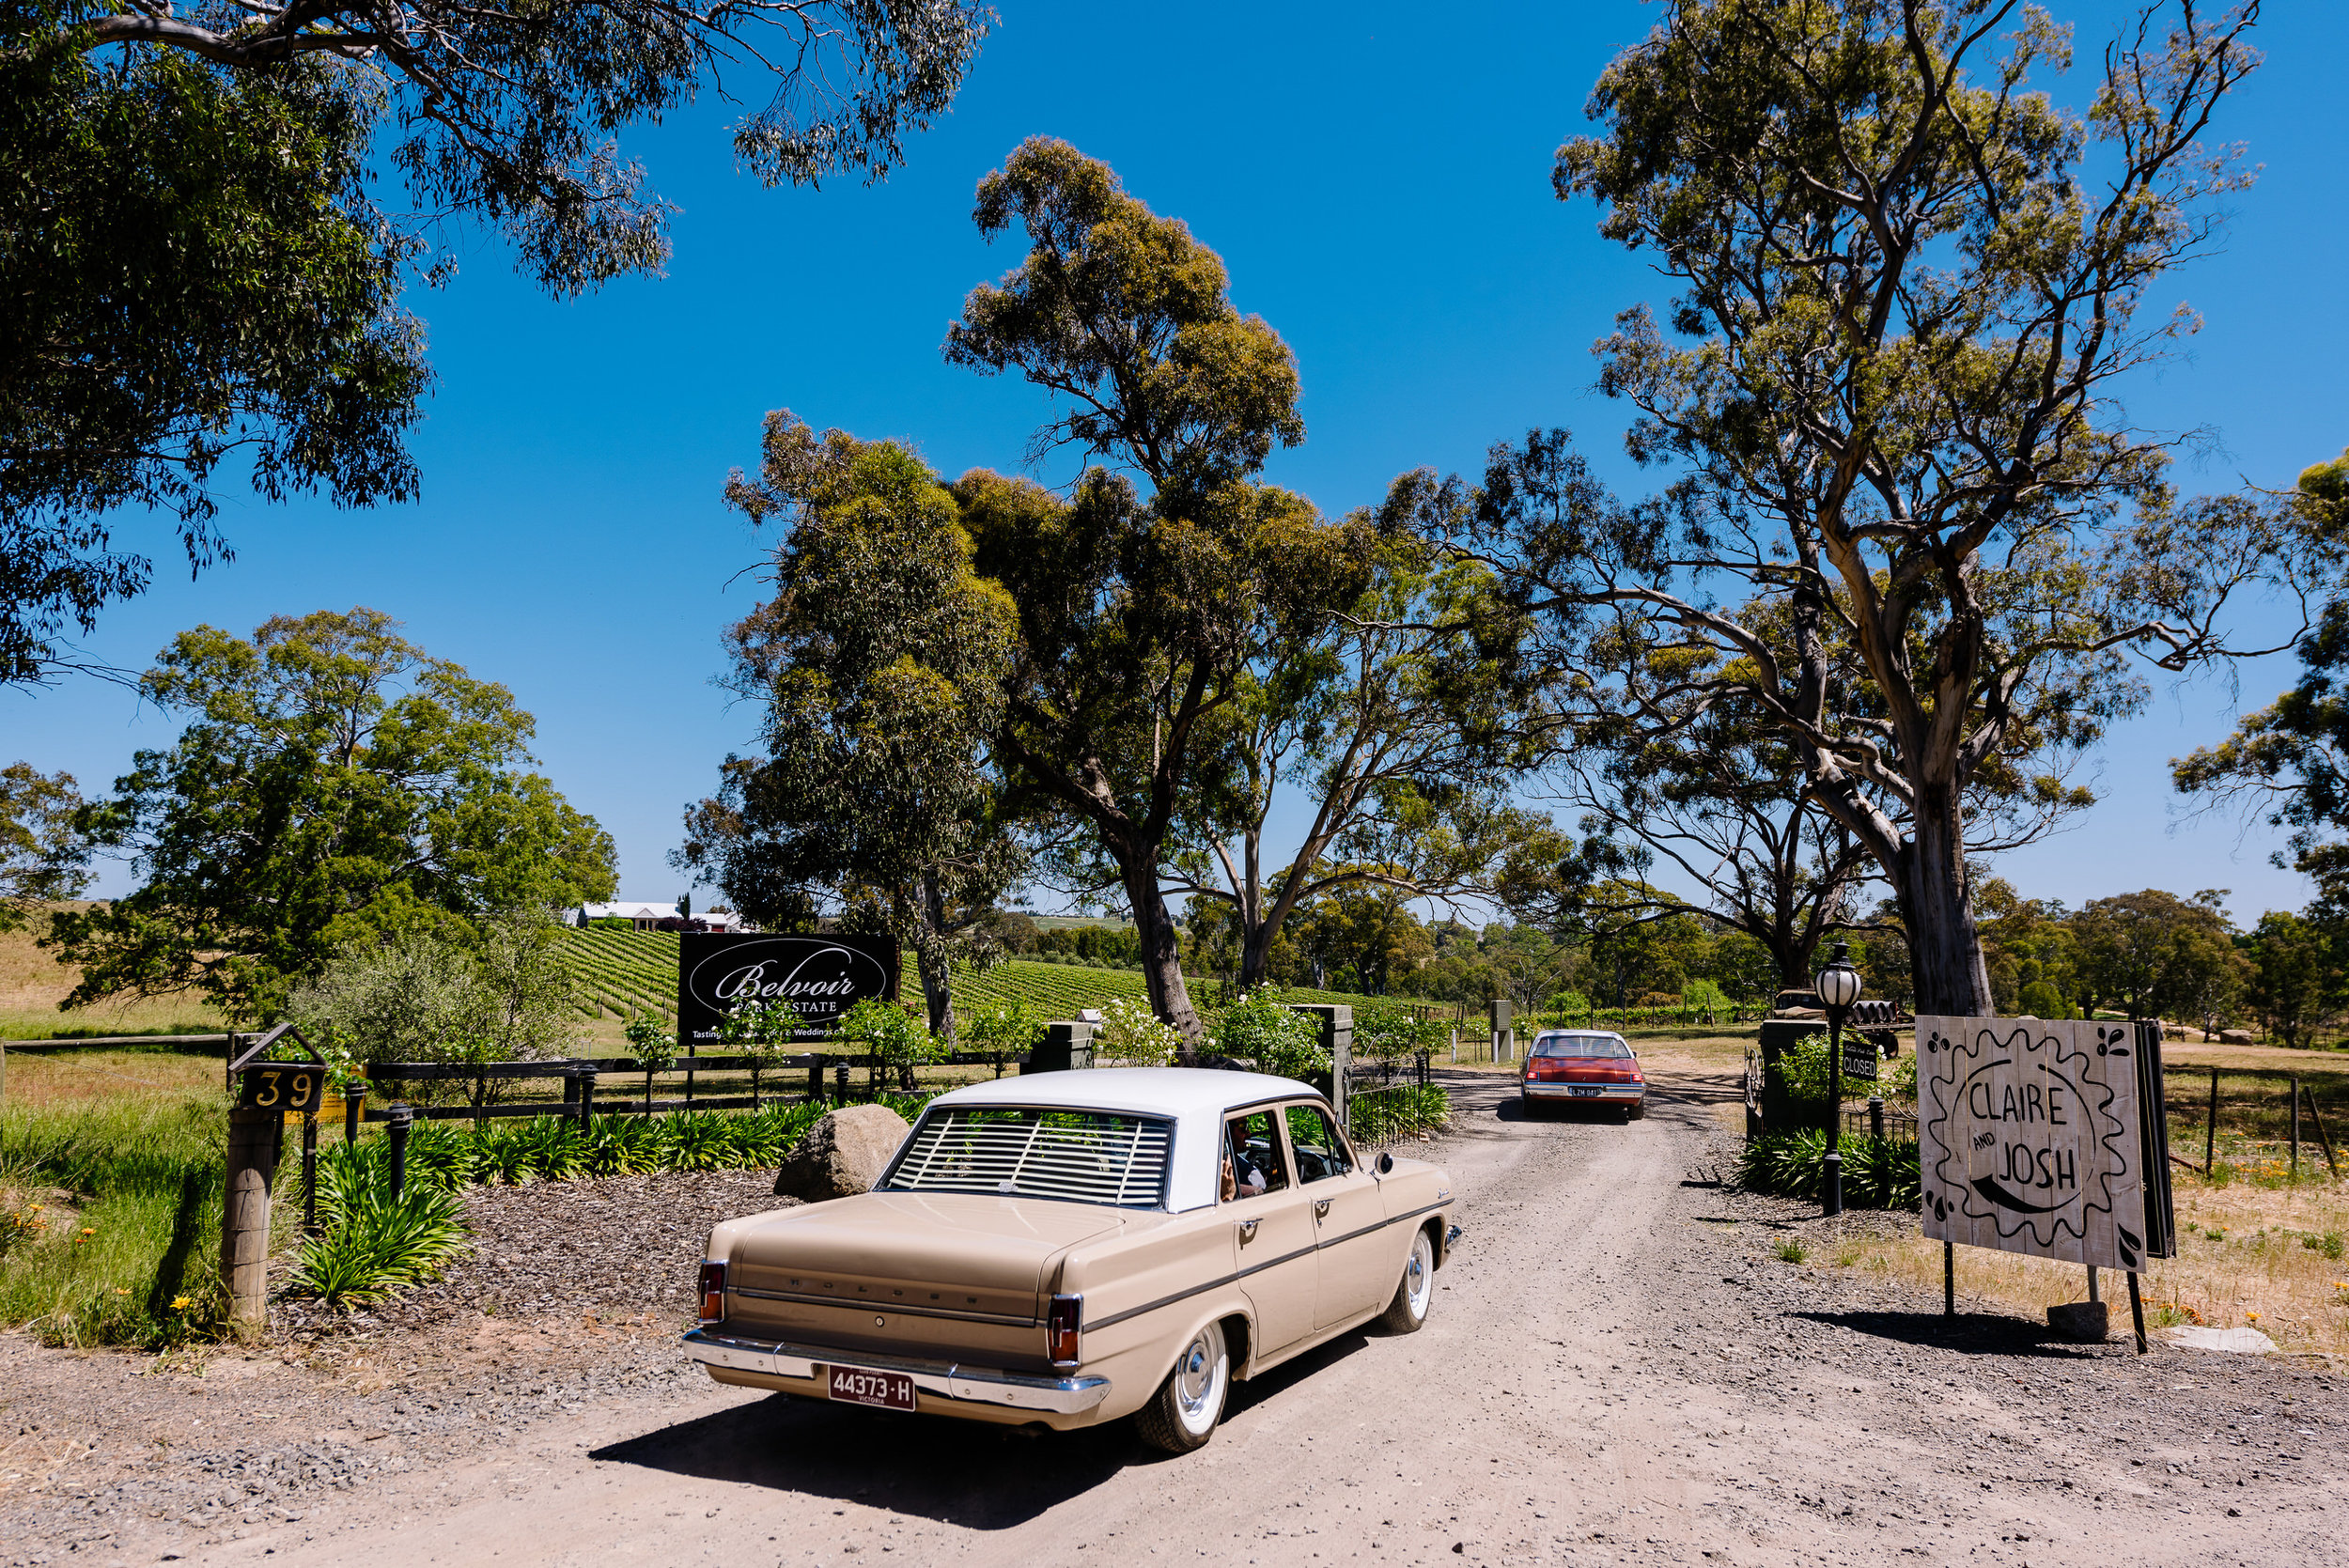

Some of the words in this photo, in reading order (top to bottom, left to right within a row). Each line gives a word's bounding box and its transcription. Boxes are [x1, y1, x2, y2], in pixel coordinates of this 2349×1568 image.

[715, 947, 855, 999] Belvoir
[692, 1030, 723, 1040] Tasting
[1843, 1056, 1876, 1077] CLOSED
[256, 1071, 312, 1108] 39
[1968, 1081, 2067, 1126] CLAIRE
[1972, 1131, 1996, 1151] AND
[1999, 1141, 2075, 1190] JOSH
[858, 1395, 885, 1405] VICTORIA
